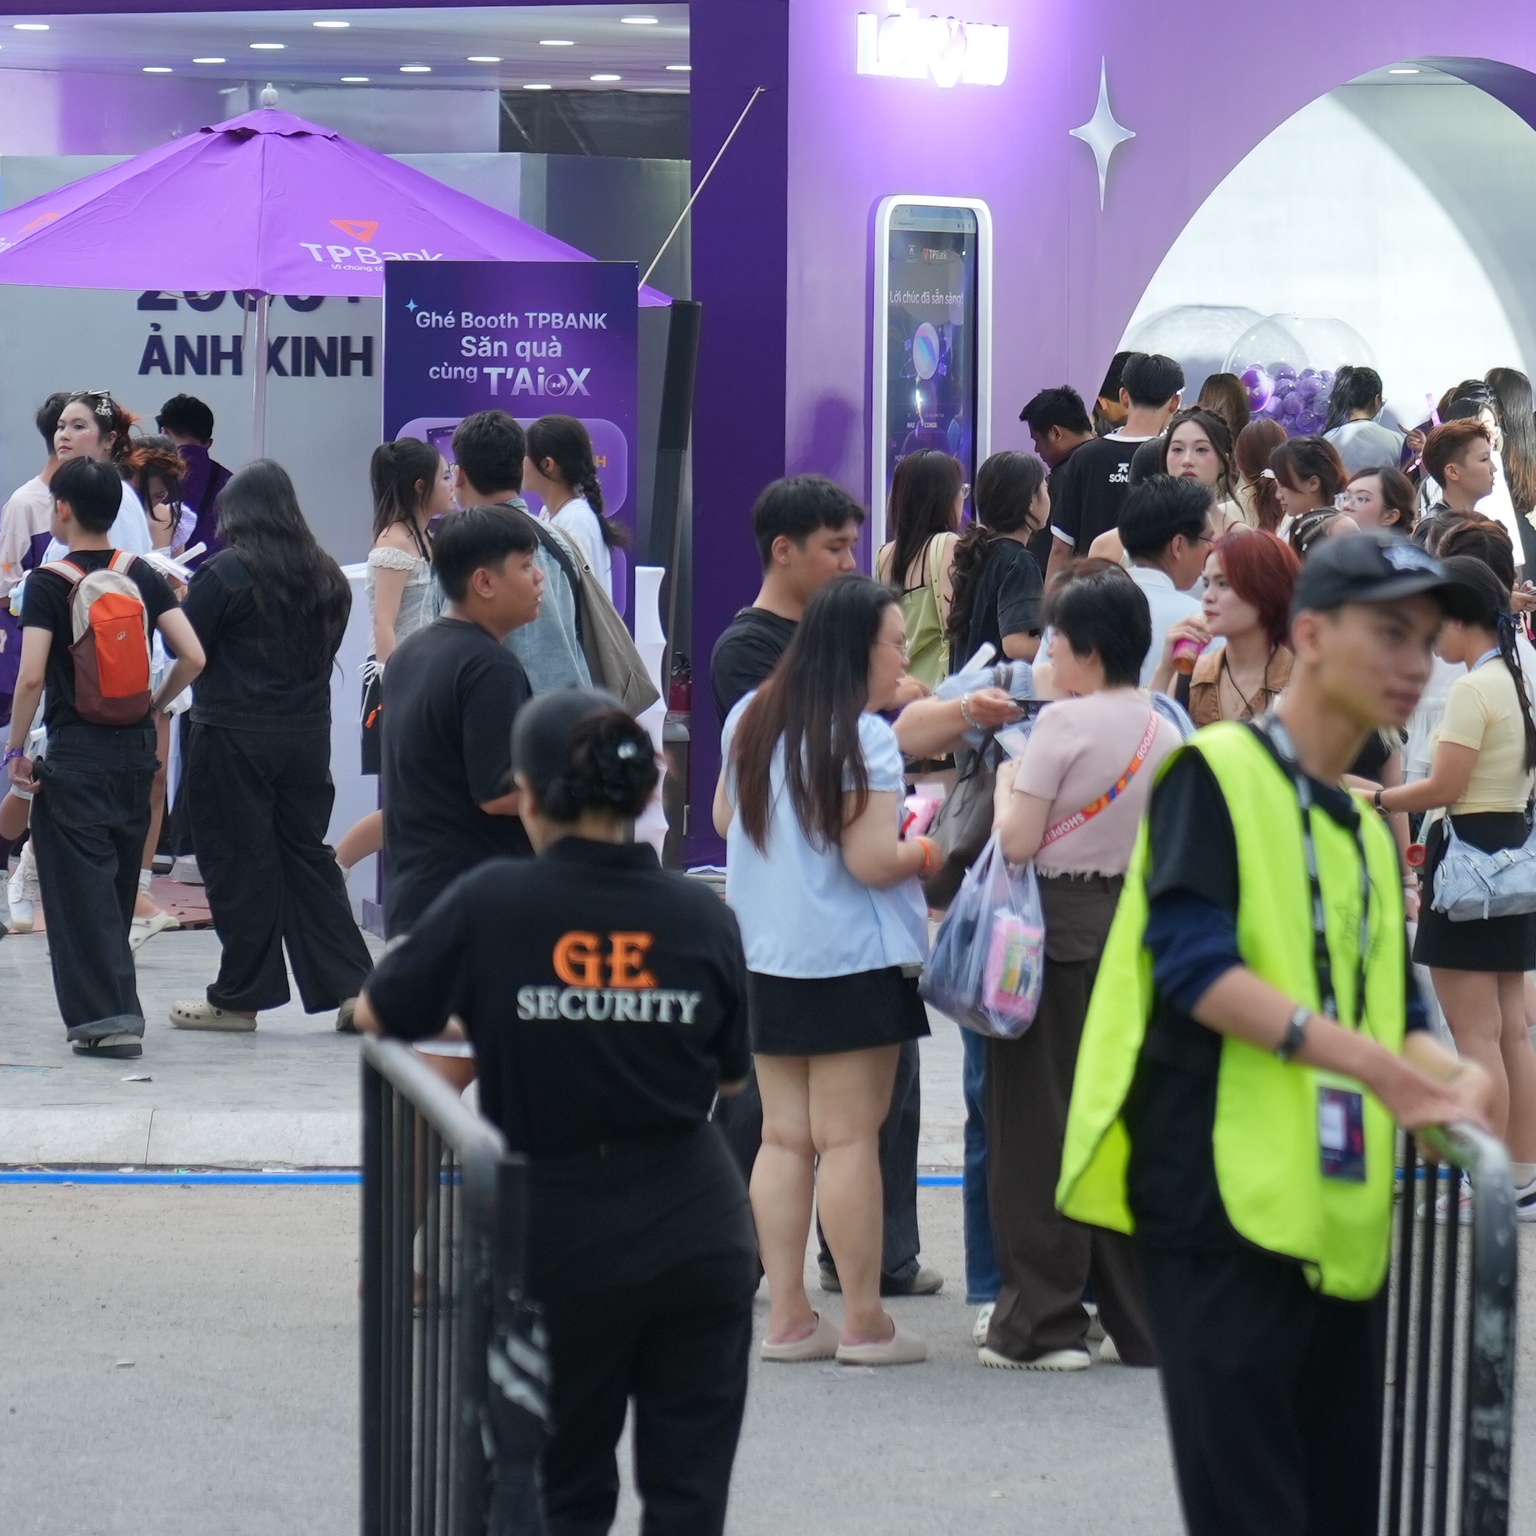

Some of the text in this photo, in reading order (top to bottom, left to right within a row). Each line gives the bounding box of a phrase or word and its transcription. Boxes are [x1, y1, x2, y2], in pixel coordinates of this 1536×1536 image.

[890, 290, 902, 304] Lời
[902, 290, 920, 304] chúc
[415, 309, 608, 331] Ghé Booth TPBANK
[137, 322, 374, 377] ẢNH XINH
[460, 334, 563, 363] Săn quà
[428, 361, 479, 384] cùng
[551, 929, 658, 990] GE
[516, 985, 702, 1024] SECURITY
